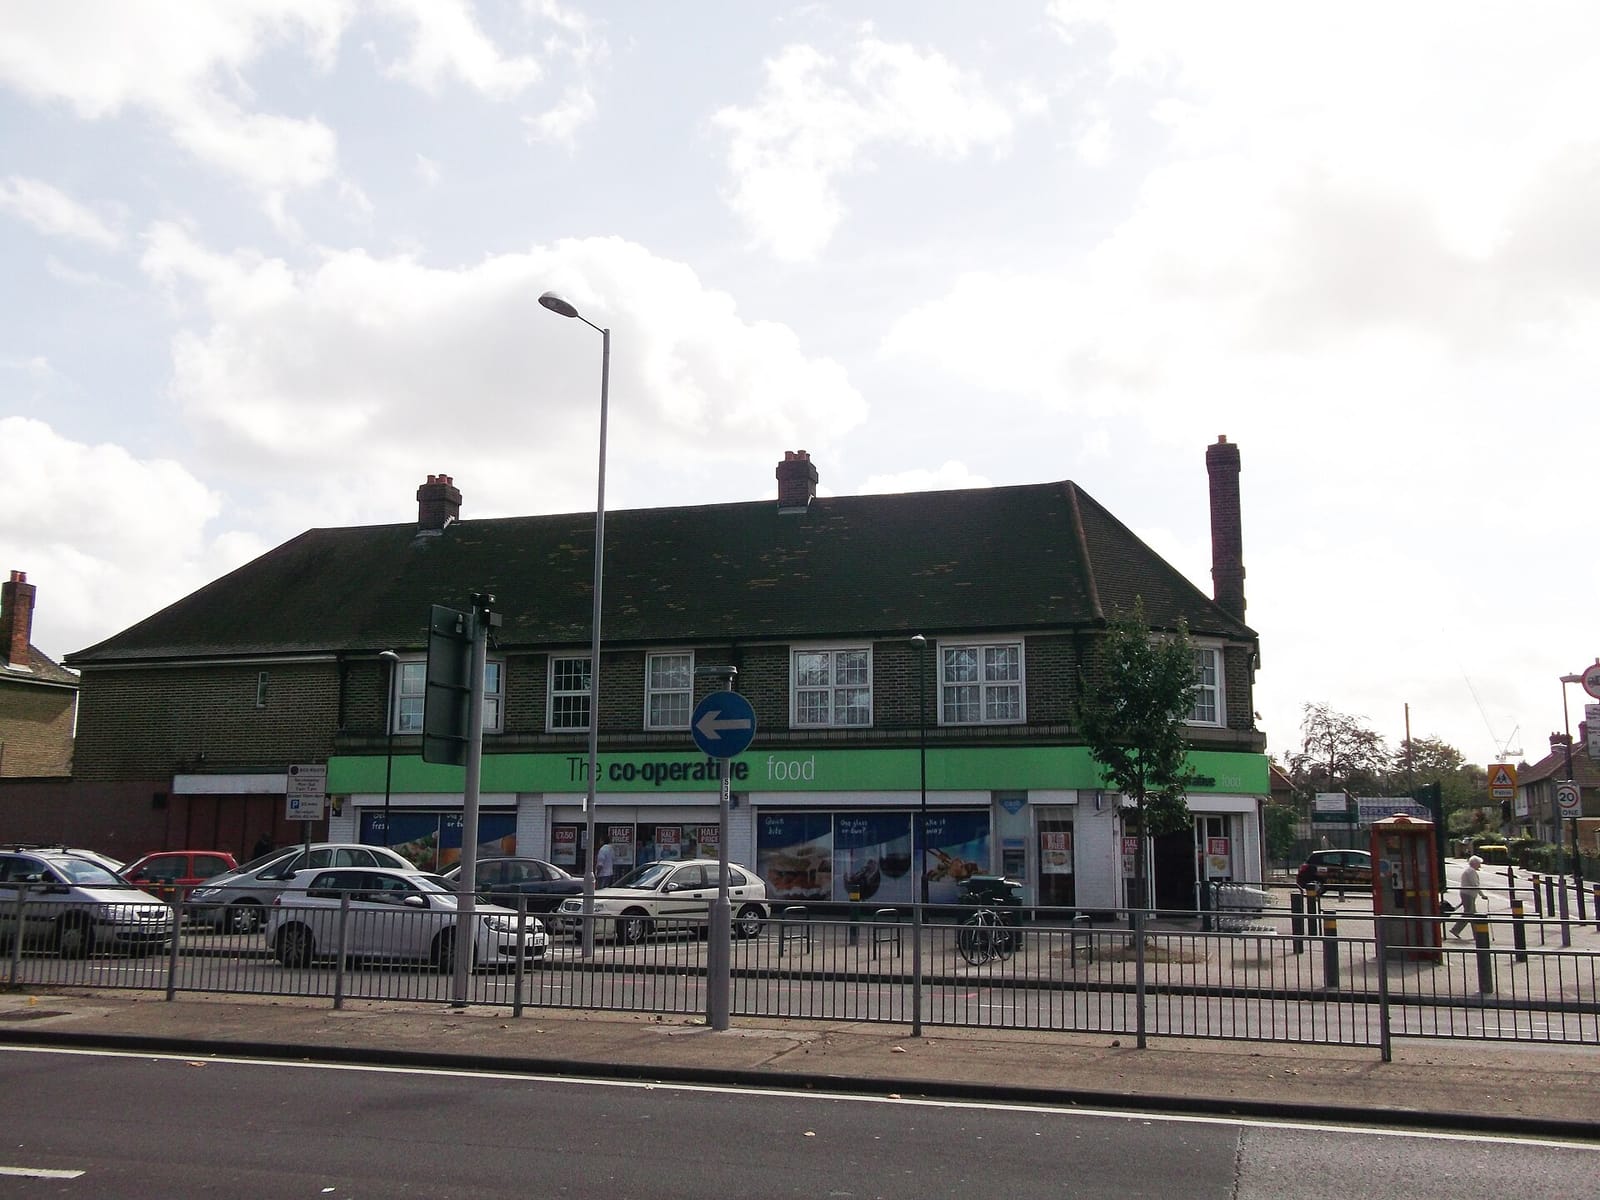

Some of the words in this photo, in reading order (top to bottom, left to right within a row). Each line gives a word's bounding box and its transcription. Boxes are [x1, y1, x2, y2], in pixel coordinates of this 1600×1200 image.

[566, 756, 602, 782] The
[767, 755, 816, 782] food
[1559, 792, 1575, 802] 20
[925, 817, 937, 826] ake
[611, 828, 630, 836] HALF
[701, 827, 719, 836] HALF
[1124, 839, 1138, 848] HAL
